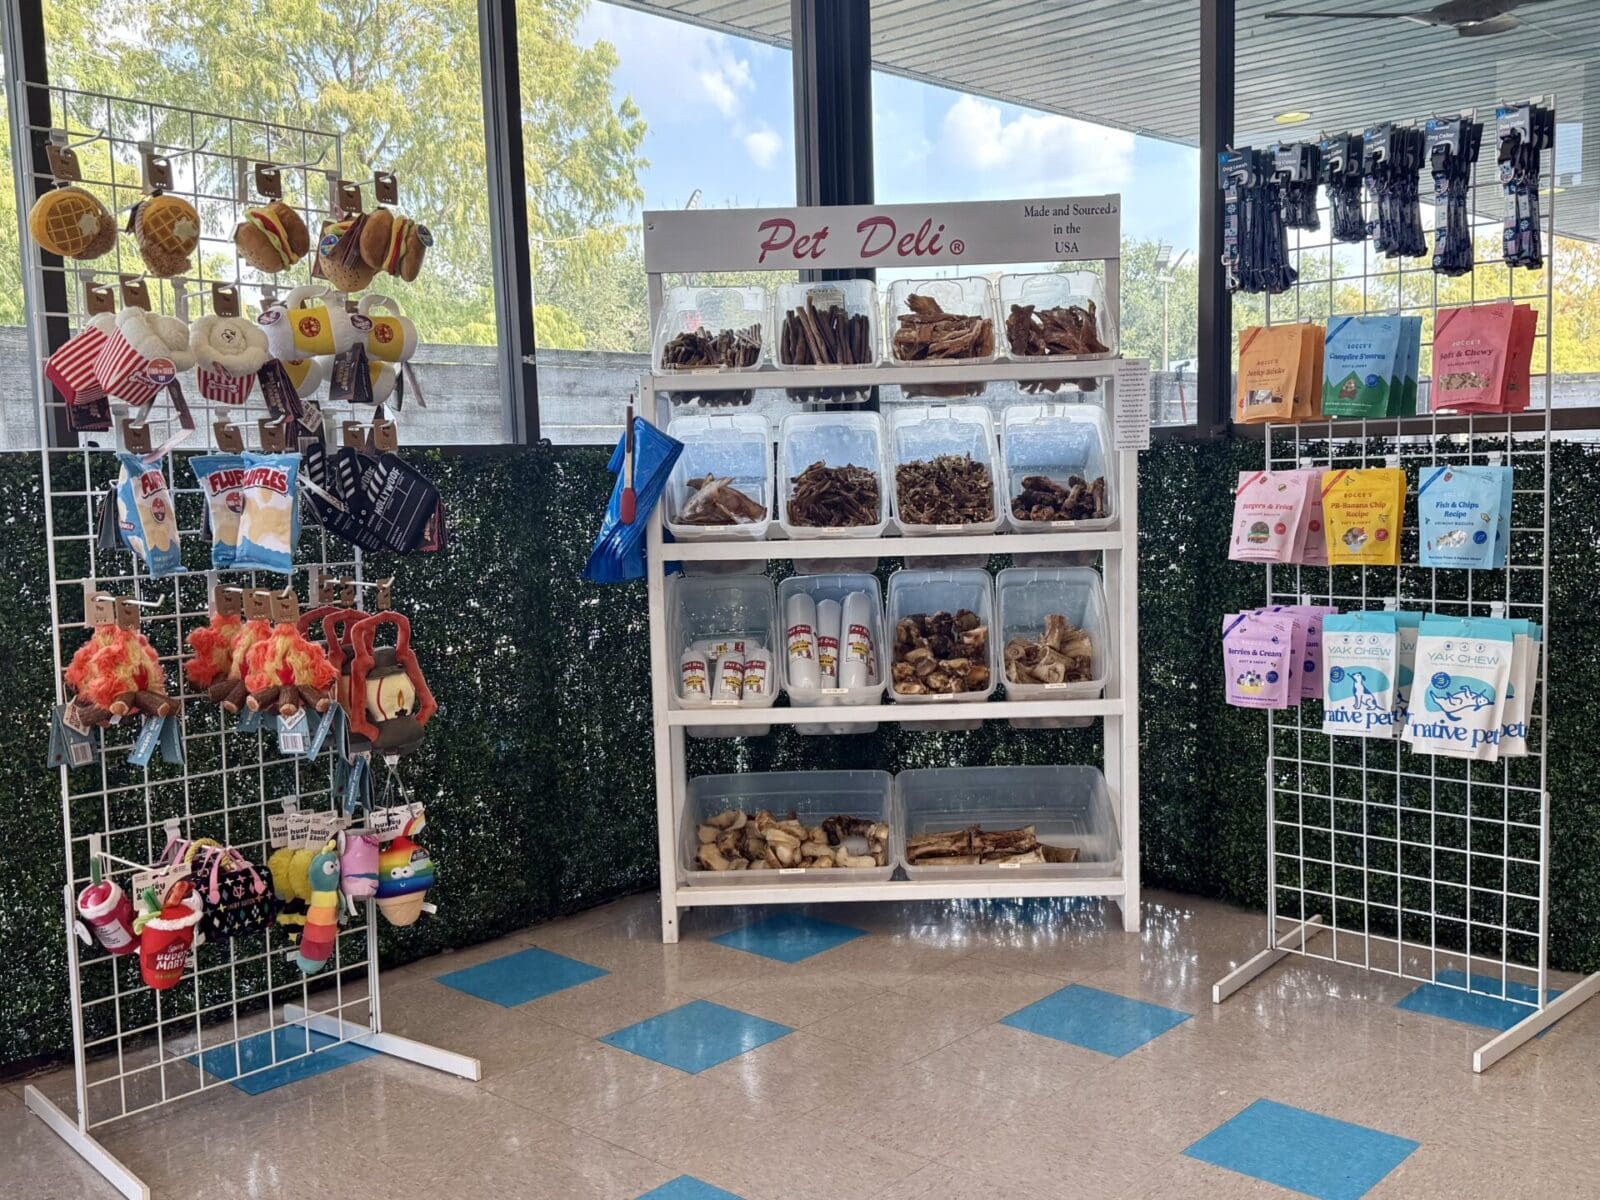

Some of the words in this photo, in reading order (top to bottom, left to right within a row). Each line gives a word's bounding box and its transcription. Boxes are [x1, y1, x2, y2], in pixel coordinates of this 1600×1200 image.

[1024, 204, 1050, 218] Made
[1052, 204, 1070, 217] and
[1072, 202, 1111, 216] Sourced
[1053, 224, 1063, 235] in
[1066, 222, 1081, 235] the
[757, 218, 829, 264] Pet
[856, 215, 945, 258] Deli
[1055, 241, 1079, 254] USA
[1329, 352, 1359, 362] Campfire
[1359, 352, 1386, 360] S'mores
[1455, 350, 1463, 358] &
[1464, 348, 1494, 357] Chewy
[1247, 369, 1266, 379] Jerky
[1266, 366, 1286, 376] Sticks
[208, 468, 245, 494] FLUF
[373, 465, 401, 517] HOLLYWOOF
[1275, 503, 1294, 511] Fries
[1369, 501, 1387, 509] Chip
[1435, 501, 1450, 509] Fish
[1458, 501, 1479, 510] Chips
[1444, 510, 1467, 519] Recipe
[1228, 647, 1251, 656] Berries
[1259, 649, 1282, 658] Cream
[1327, 646, 1352, 655] YAK
[1354, 647, 1391, 657] CHEW
[1426, 652, 1455, 663] YAK
[1457, 654, 1500, 666] CHEW
[1323, 706, 1363, 724] native
[1412, 719, 1468, 741] native
[1471, 727, 1501, 748] pet
